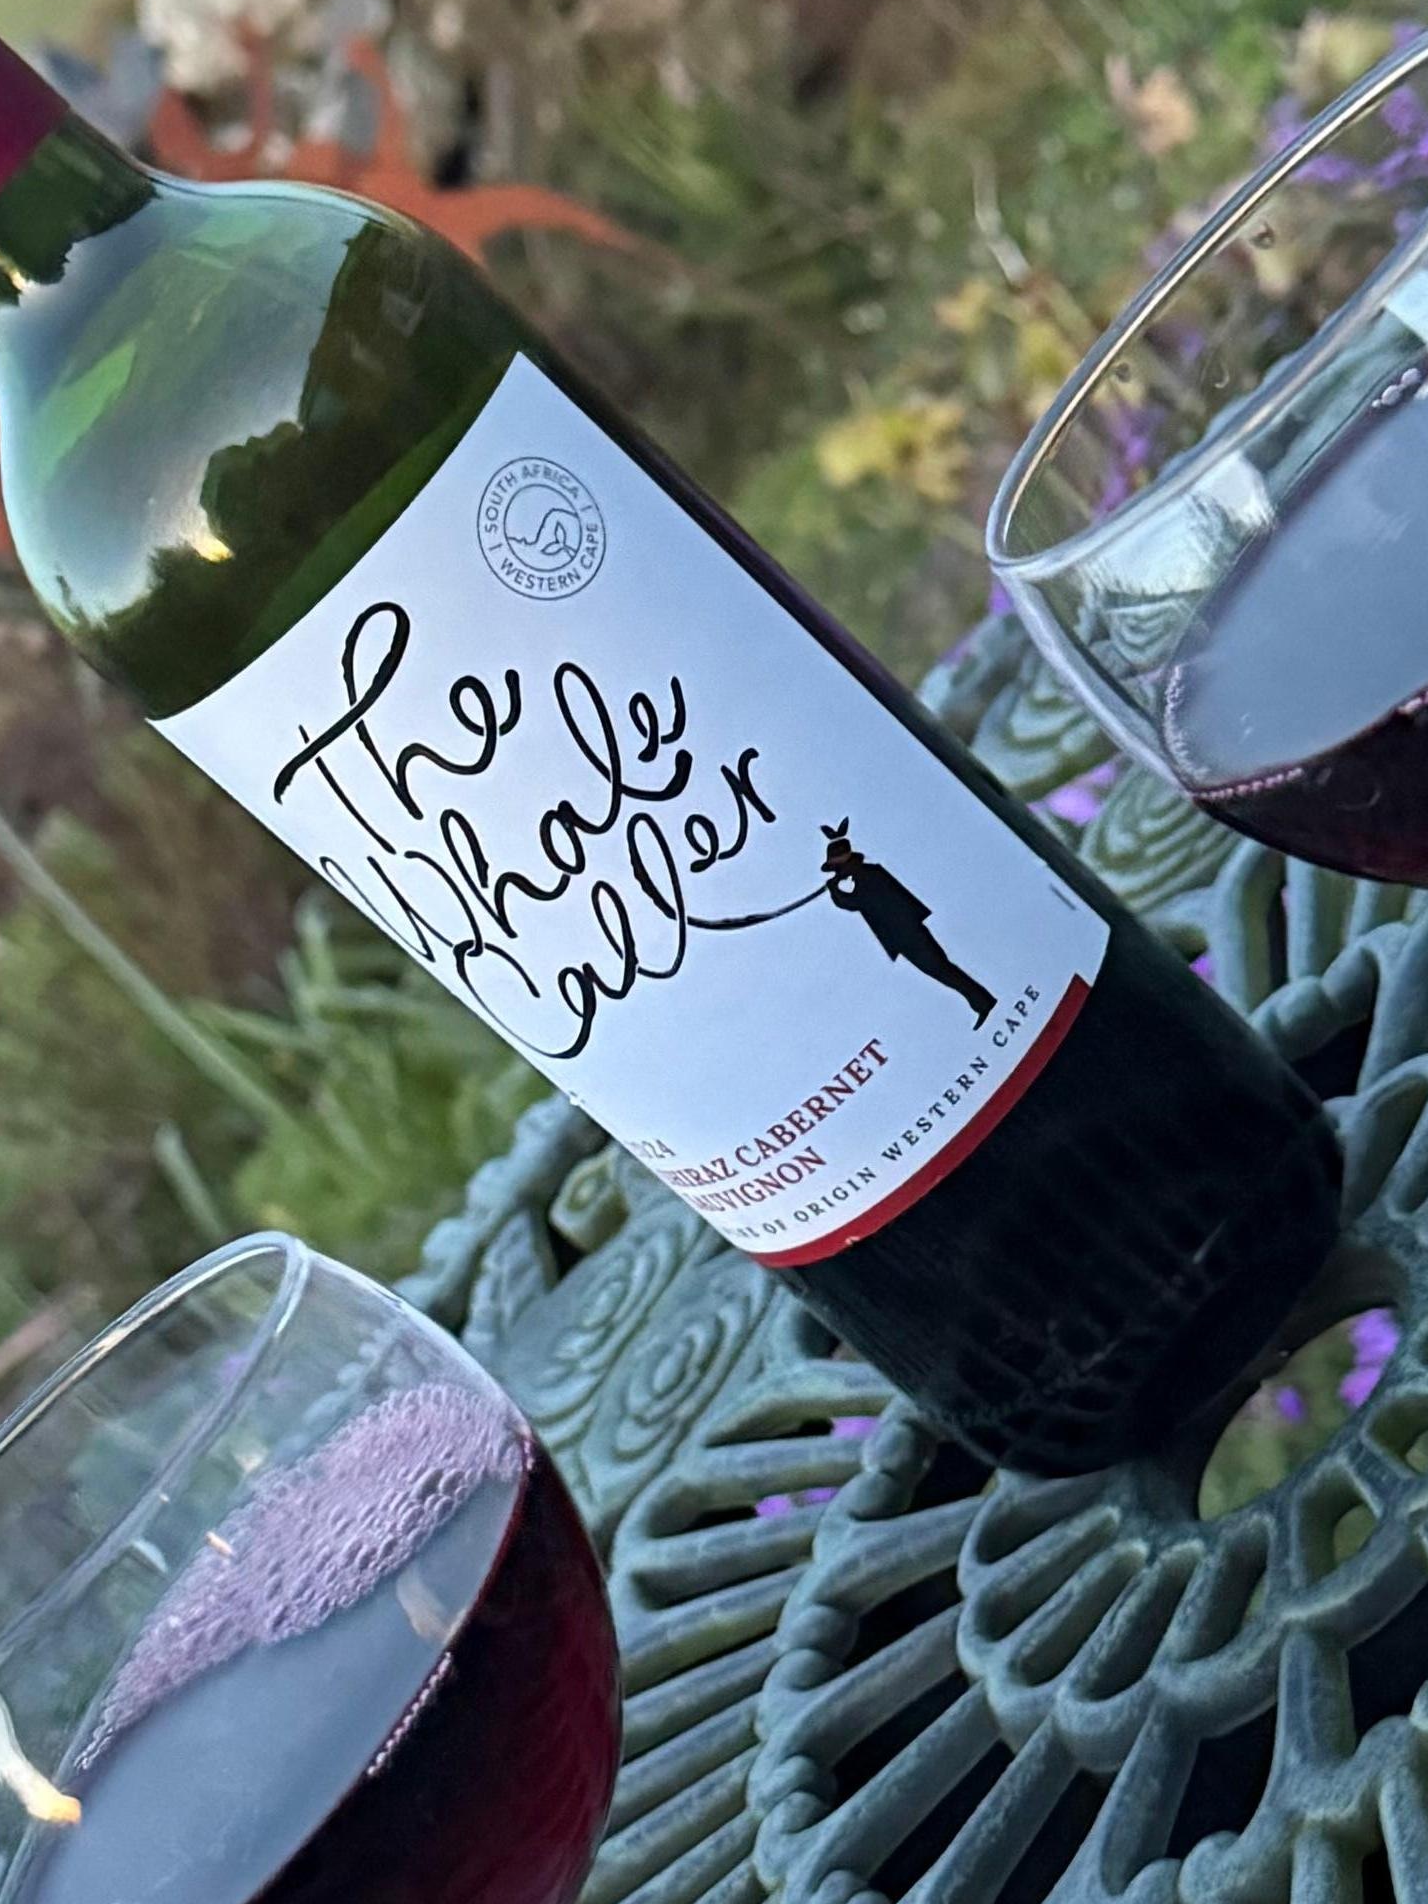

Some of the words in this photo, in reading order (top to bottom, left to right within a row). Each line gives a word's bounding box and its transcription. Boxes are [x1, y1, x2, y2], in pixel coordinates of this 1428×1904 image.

[484, 471, 518, 535] SOUTH
[521, 463, 580, 499] AFRICA
[500, 557, 582, 592] WESTERN
[580, 522, 599, 570] CAPE
[273, 601, 523, 855] The
[320, 661, 693, 964] Whale
[452, 747, 777, 1060] Caller
[625, 1138, 677, 1160] 24
[657, 1157, 740, 1188] HIRAZ
[735, 1037, 889, 1169] CABERNET
[681, 1146, 828, 1212] AUVIGNON
[794, 1166, 878, 1223] ORIGIN
[881, 1056, 990, 1163] WESTERN
[992, 984, 1041, 1048] CAPE
